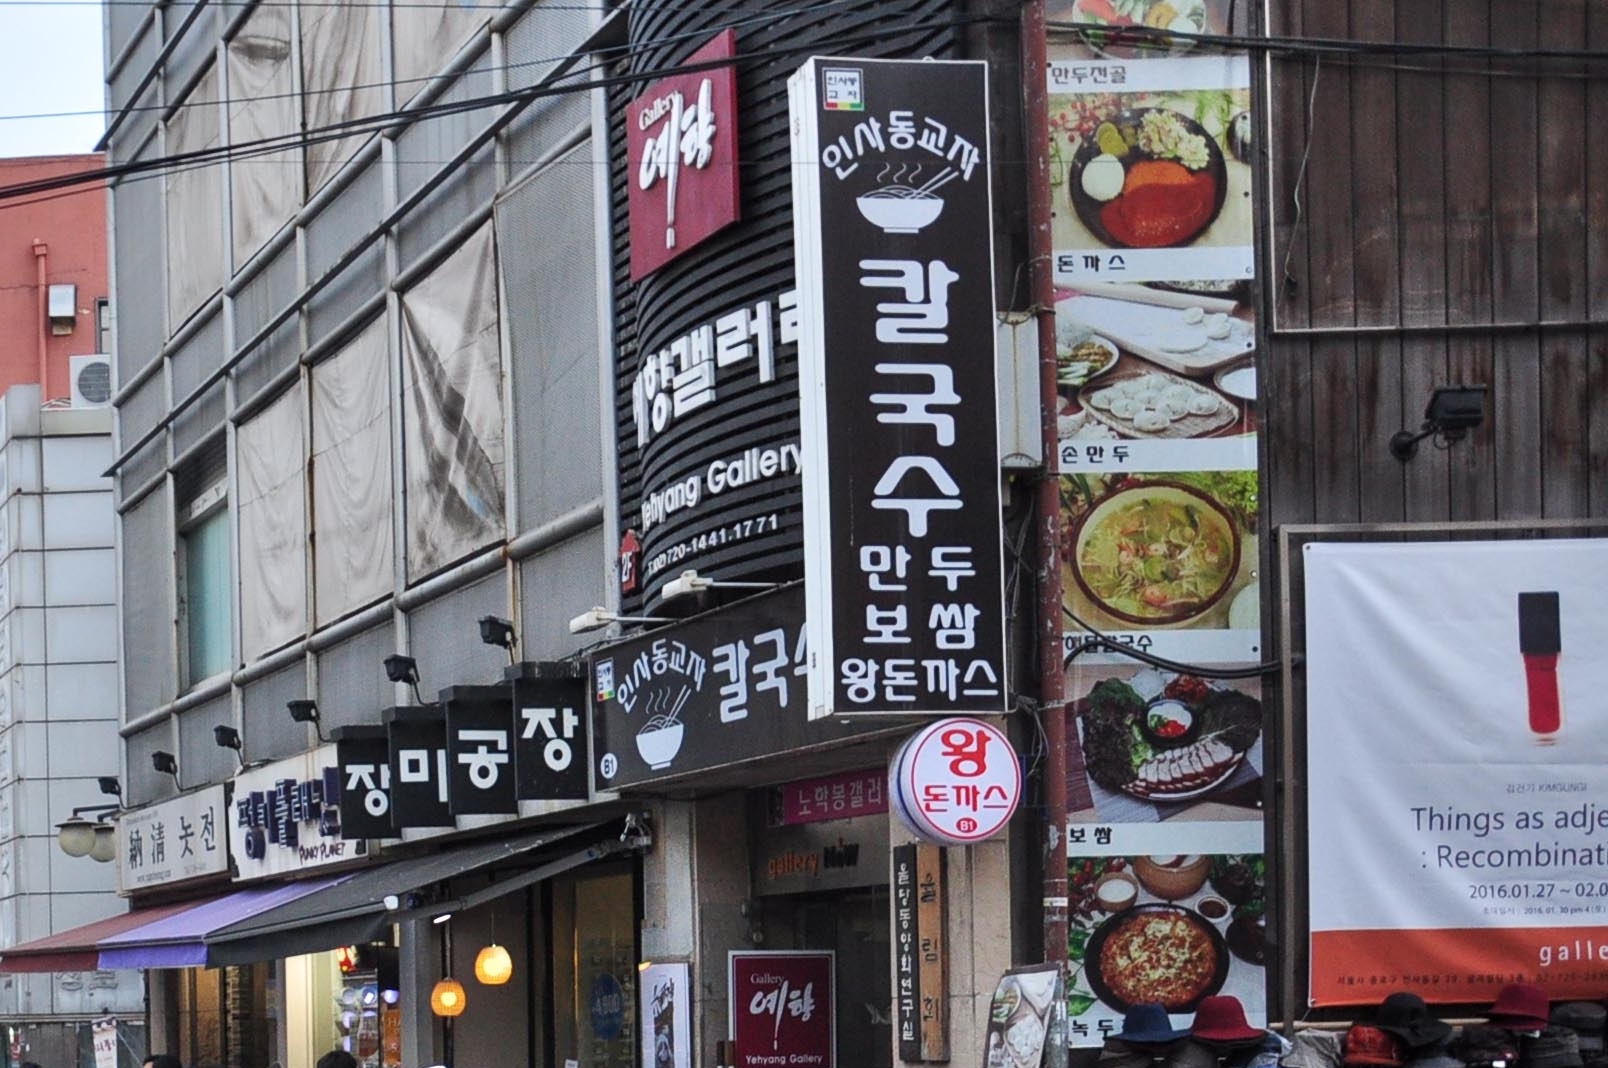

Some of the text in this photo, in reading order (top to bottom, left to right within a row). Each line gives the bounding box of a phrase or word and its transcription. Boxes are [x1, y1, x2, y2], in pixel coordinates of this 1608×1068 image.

[1051, 66, 1127, 84] 만두전골
[822, 110, 980, 182] 인사동교자
[1057, 253, 1126, 273] 돈까스
[859, 258, 962, 538] 칼국수
[707, 443, 803, 494] Gallery
[1060, 443, 1130, 464] 손만두
[859, 545, 976, 592] 만두
[863, 603, 981, 650] 보쌈
[617, 637, 707, 714] 인사동교자
[841, 657, 999, 703] 왕돈까스
[345, 707, 579, 817] 장미공장
[603, 757, 616, 775] B1
[940, 728, 992, 778] 왕
[922, 785, 1009, 813] 돈까스
[959, 820, 975, 832] B1
[1068, 826, 1112, 845] 보쌈
[1410, 805, 1505, 838] Things
[1514, 810, 1545, 830] as
[1469, 883, 1556, 900] 2016.01.27
[750, 972, 785, 986] Gallery
[745, 1053, 824, 1066] Yehyang Gallery
